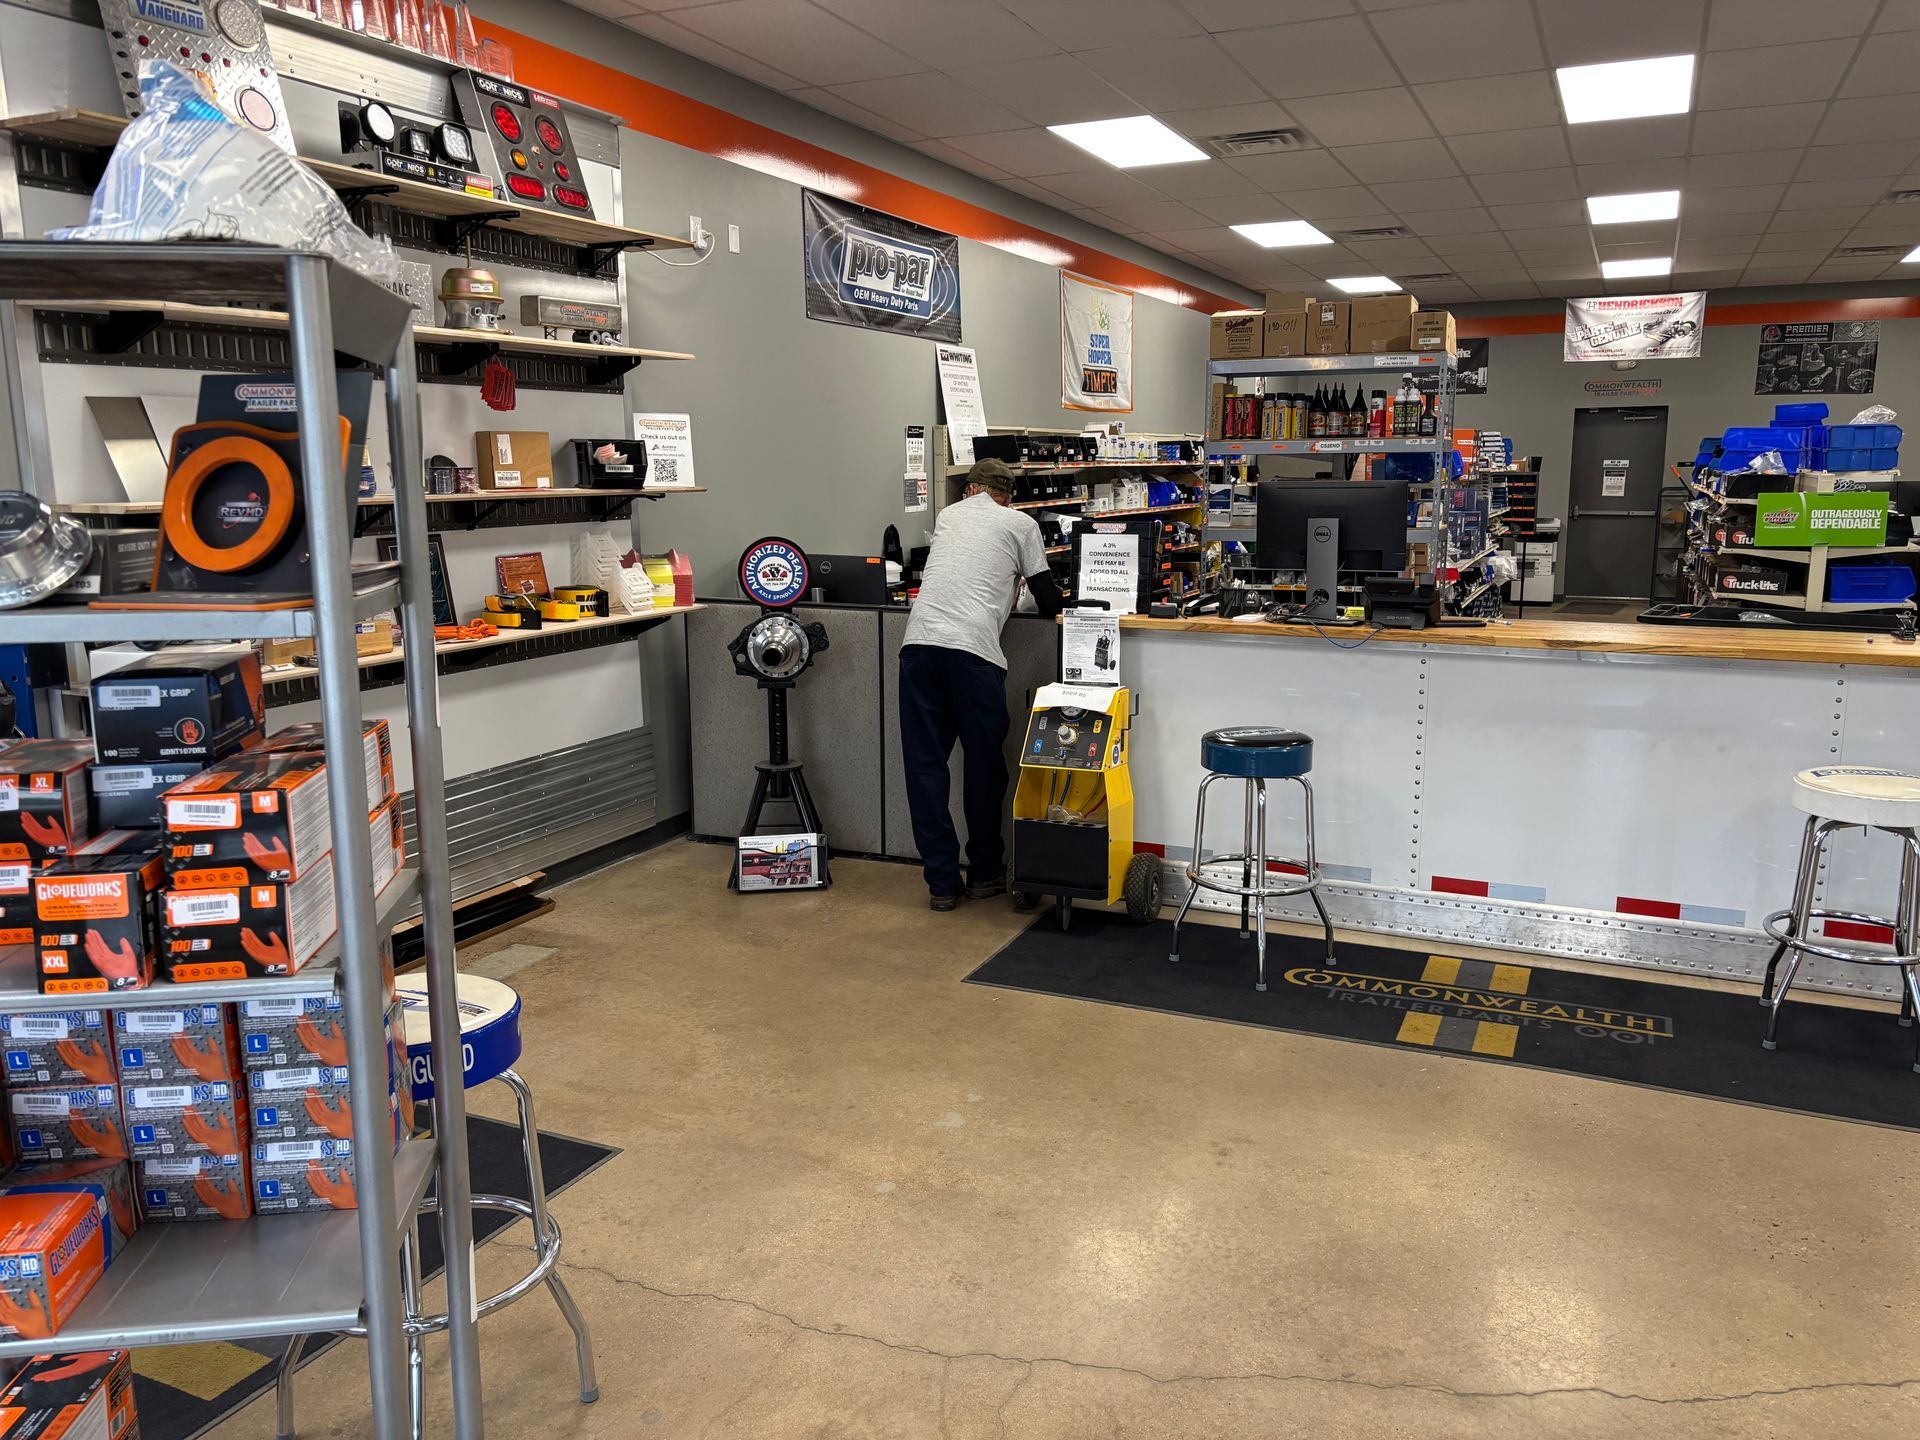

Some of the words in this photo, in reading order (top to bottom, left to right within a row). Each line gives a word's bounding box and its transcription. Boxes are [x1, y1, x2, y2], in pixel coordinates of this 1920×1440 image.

[136, 0, 204, 30] VANGUARD
[847, 237, 930, 292] pro-par
[854, 288, 870, 299] OEM
[870, 291, 890, 307] Heavy
[890, 297, 904, 310] Duty
[904, 299, 919, 311] Parts
[1576, 322, 1614, 342] PARTS
[1590, 323, 1642, 347] GENUINE
[1785, 324, 1829, 334] PREMIER
[1090, 333, 1110, 349] SUPER
[949, 351, 973, 364] WHITING
[1088, 349, 1112, 365] HOPPER
[1084, 370, 1116, 393] TIMPTE
[1584, 381, 1660, 391] COMMONWEALTH
[235, 384, 296, 400] COMMONW
[220, 507, 264, 517] REVHD
[1811, 509, 1883, 518] OUTRAGEOUSLY
[1810, 518, 1881, 529] DEPENDABLE
[745, 544, 786, 590] AUTHORIZED
[786, 551, 803, 590] DEALER
[758, 589, 772, 599] AXLE
[772, 588, 794, 600] SPINDLE
[1086, 585, 1130, 593] TRANSACTIONS
[103, 750, 118, 758] 100
[35, 777, 49, 788] XL
[258, 795, 271, 808] M
[38, 880, 122, 901] GLOVEWORKS
[257, 890, 270, 903] M
[44, 955, 67, 968] XXL
[1284, 967, 1655, 1032] COMMONWEALTH
[203, 1008, 217, 1019] HD
[1325, 986, 1444, 1015] TRAILER
[1460, 1007, 1553, 1031] PARTS
[86, 1010, 100, 1023] HD
[254, 1039, 262, 1049] L
[15, 1055, 23, 1065] L
[129, 1053, 137, 1063] L
[335, 1067, 348, 1078] HD
[99, 1089, 112, 1101] HD
[213, 1084, 227, 1095] HD
[263, 1112, 271, 1122] L
[140, 1130, 148, 1139] L
[337, 1140, 350, 1151] HD
[266, 1184, 273, 1194] L
[153, 1193, 160, 1202] L
[50, 1205, 99, 1278] GLOVEWORKS
[21, 1257, 37, 1271] HD
